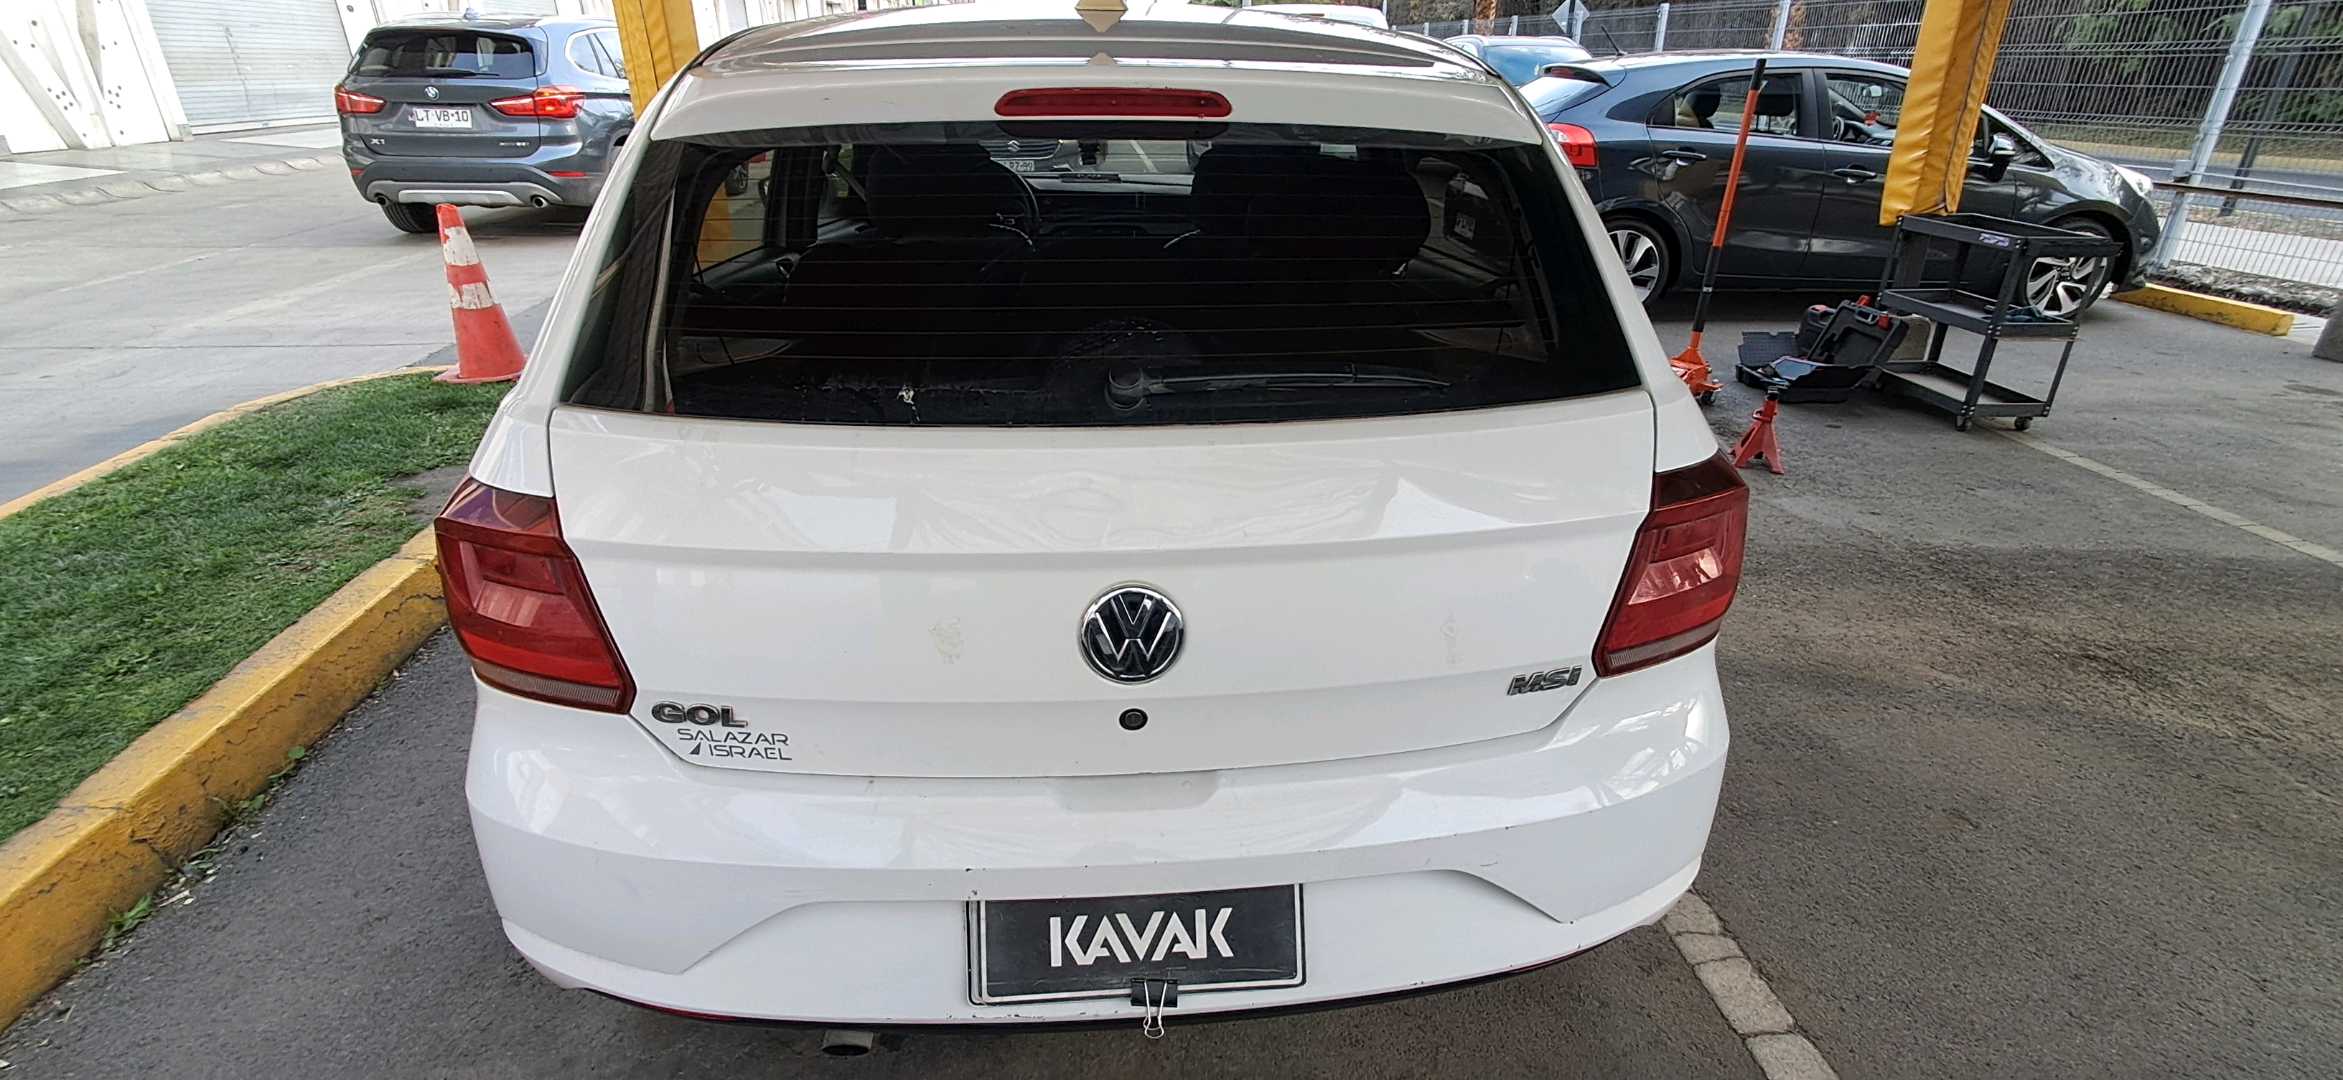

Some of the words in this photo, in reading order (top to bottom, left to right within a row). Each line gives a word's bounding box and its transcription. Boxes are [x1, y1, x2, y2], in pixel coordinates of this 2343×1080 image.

[1507, 665, 1582, 696] MSI
[651, 700, 749, 728] GOL
[677, 728, 789, 746] SALAZAR
[709, 743, 793, 761] ISRAEL
[1049, 907, 1234, 967] KAVAK
